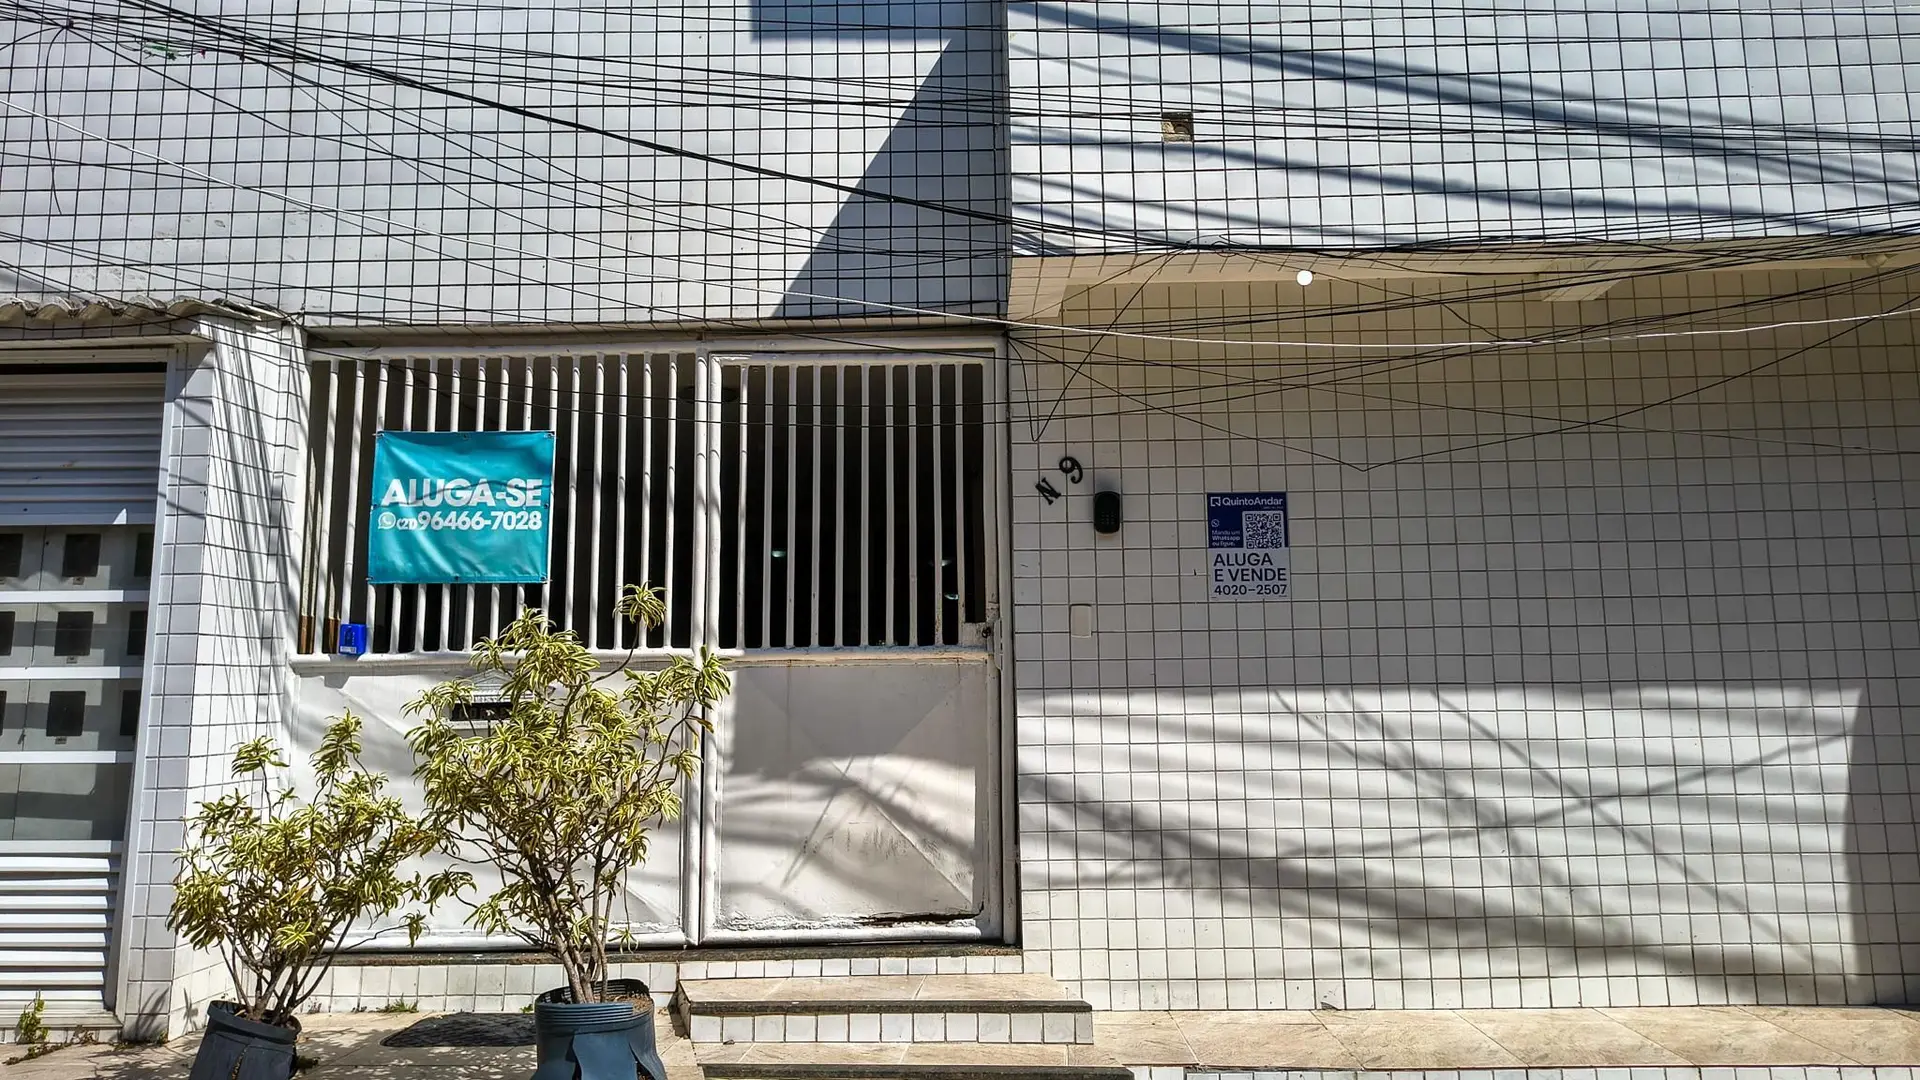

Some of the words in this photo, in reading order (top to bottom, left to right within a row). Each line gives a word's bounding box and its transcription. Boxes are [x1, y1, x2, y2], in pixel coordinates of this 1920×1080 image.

[1035, 477, 1061, 505] N
[1059, 456, 1083, 484] 9
[380, 478, 543, 507] ALUGA-SE
[1222, 497, 1283, 506] QuintoAndar
[417, 510, 542, 530] 96466-7028
[1213, 552, 1273, 566] ALUGA
[1214, 568, 1224, 582] E
[1228, 568, 1287, 582] VENDE
[1214, 584, 1287, 595] 4020-2507
